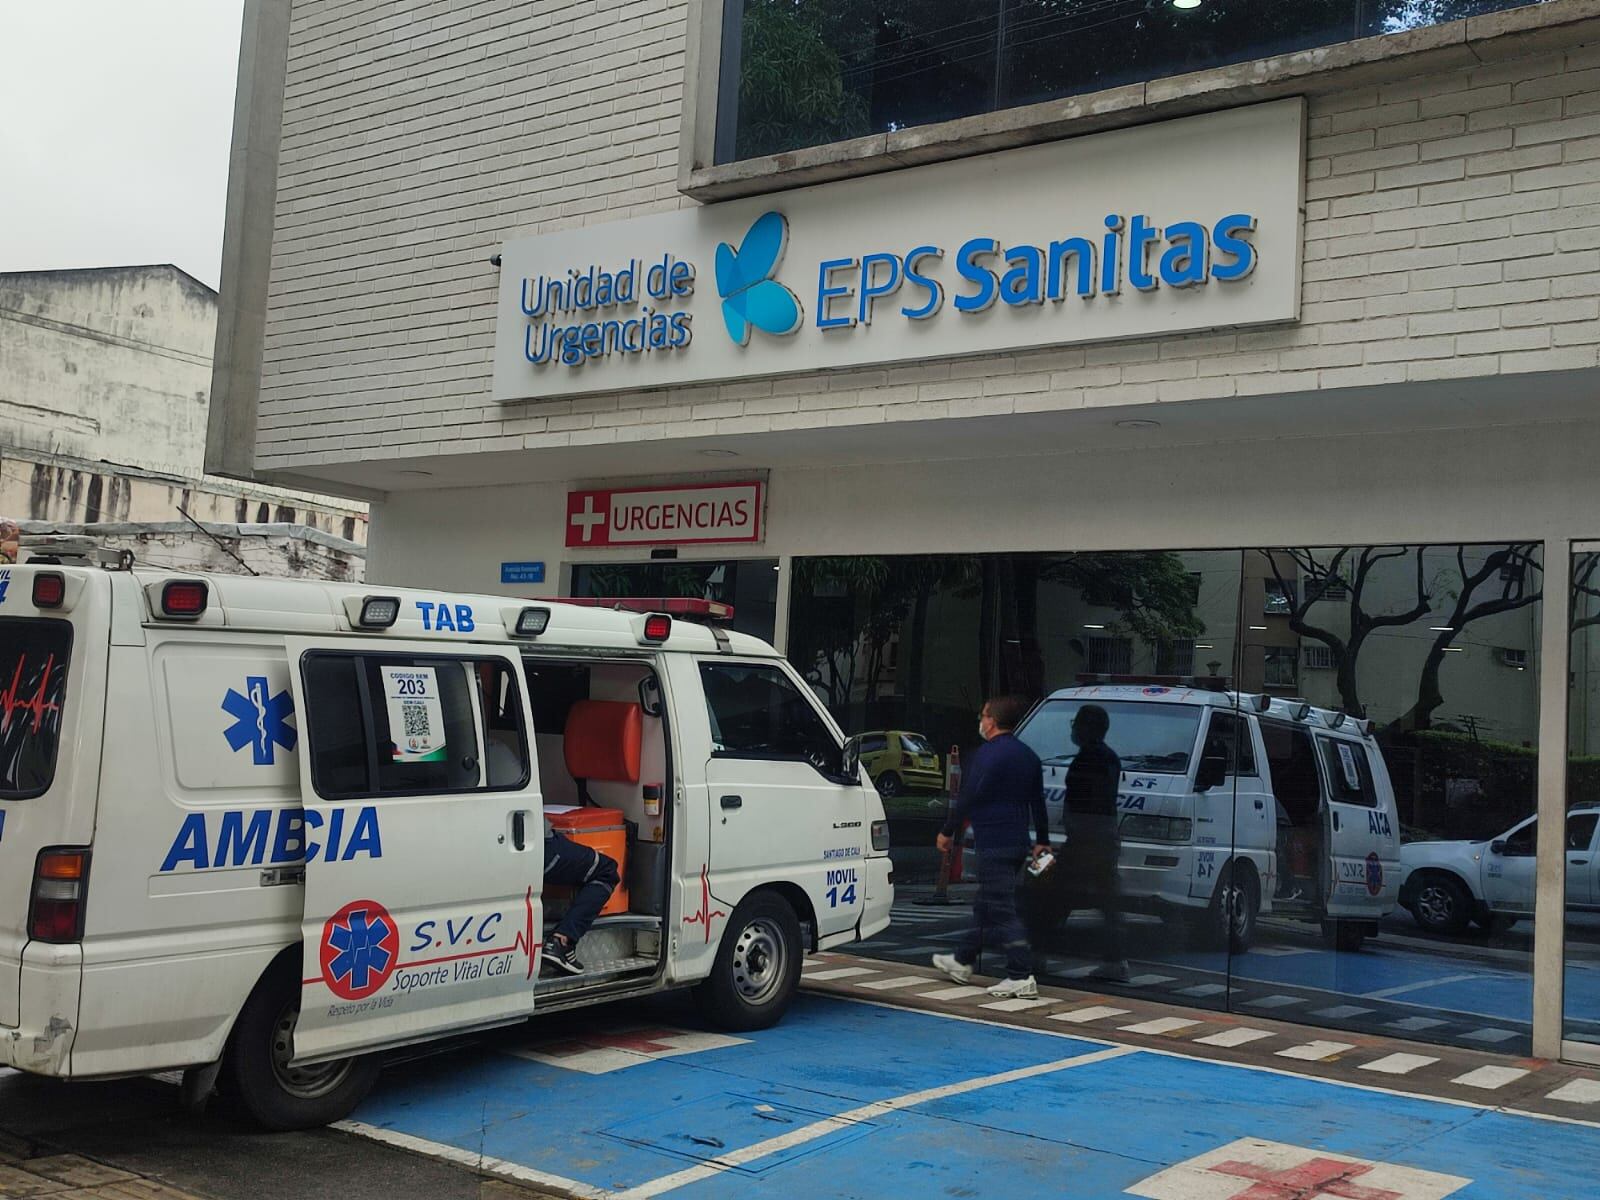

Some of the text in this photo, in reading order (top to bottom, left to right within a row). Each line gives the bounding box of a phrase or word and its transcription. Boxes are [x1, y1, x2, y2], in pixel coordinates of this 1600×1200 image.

[521, 252, 696, 318] Unidad de
[816, 213, 1256, 330] EPS Sanitas
[525, 305, 692, 366] Urgencias
[613, 500, 748, 531] URGENCIAS
[415, 601, 475, 632] TAB
[397, 679, 426, 695] 203
[827, 868, 858, 886] MOVIL
[826, 884, 857, 908] 14
[410, 912, 502, 951] S.V.C
[392, 955, 514, 993] Soporte Vital Cali
